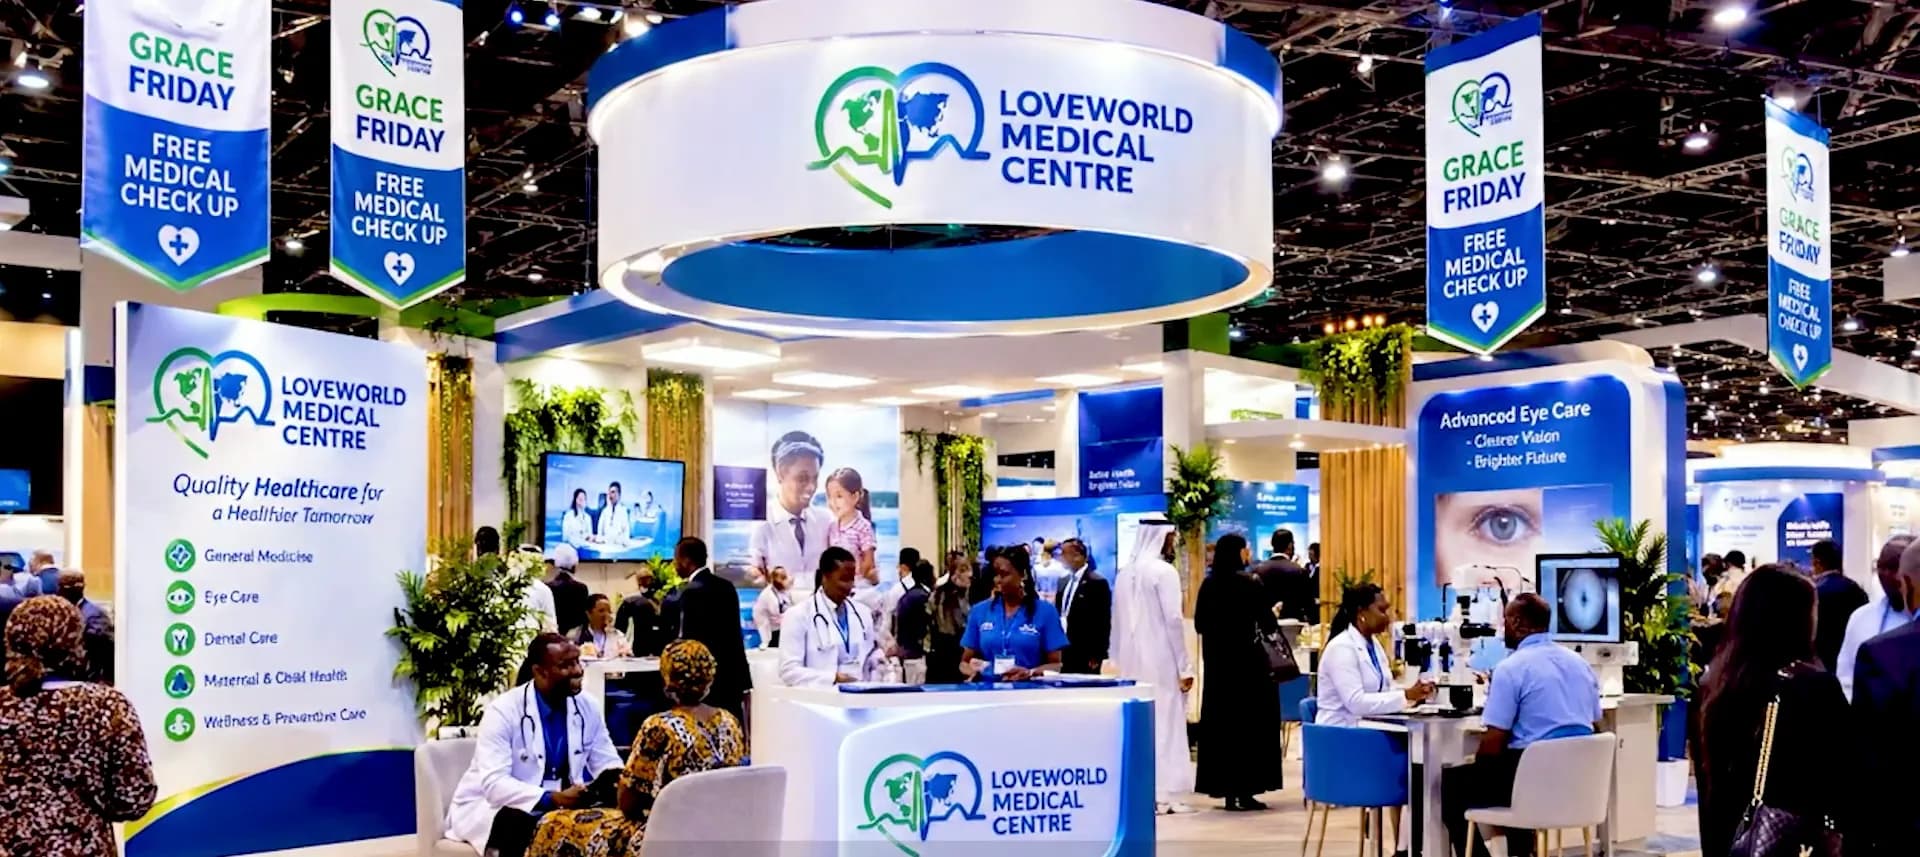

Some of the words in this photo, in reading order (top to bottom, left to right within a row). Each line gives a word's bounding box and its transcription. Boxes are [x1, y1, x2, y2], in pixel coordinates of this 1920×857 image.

[129, 32, 234, 79] GRACE
[128, 65, 235, 111] FRIDAY
[356, 84, 443, 122] GRACE
[1000, 90, 1193, 134] LOVEWORLD
[152, 133, 211, 163] FREE
[356, 115, 444, 153] FRIDAY
[1001, 123, 1155, 163] MEDICAL
[124, 154, 236, 193] MEDICAL
[1001, 156, 1134, 194] CENTRE
[1443, 141, 1524, 182] GRACE
[375, 172, 424, 196] FREE
[1444, 172, 1526, 214] FRIDAY
[120, 182, 202, 215] CHECK
[207, 194, 239, 219] UP
[354, 191, 444, 223] MEDICAL
[351, 216, 417, 243] CHECK
[422, 224, 448, 245] UP
[1779, 207, 1820, 242] GRACE
[1463, 228, 1506, 254] FREE
[1445, 247, 1525, 278] MEDICAL
[1443, 273, 1500, 299] CHECK
[1504, 267, 1528, 288] UP
[281, 376, 406, 406] LOVEWORLD
[283, 400, 380, 428] MEDICAL
[1520, 405, 1549, 426] Eye
[1552, 401, 1591, 419] Care
[283, 425, 366, 450] CENTRE
[173, 473, 250, 500] Quality
[254, 477, 358, 500] Healthcare
[360, 482, 384, 504] for
[212, 508, 222, 520] a
[230, 590, 259, 603] Care
[204, 632, 245, 646] Dental
[249, 631, 278, 644] Care
[991, 768, 1107, 790] LOVEWORLD
[993, 790, 1084, 812] MEDICAL
[992, 814, 1072, 835] CENTRE
